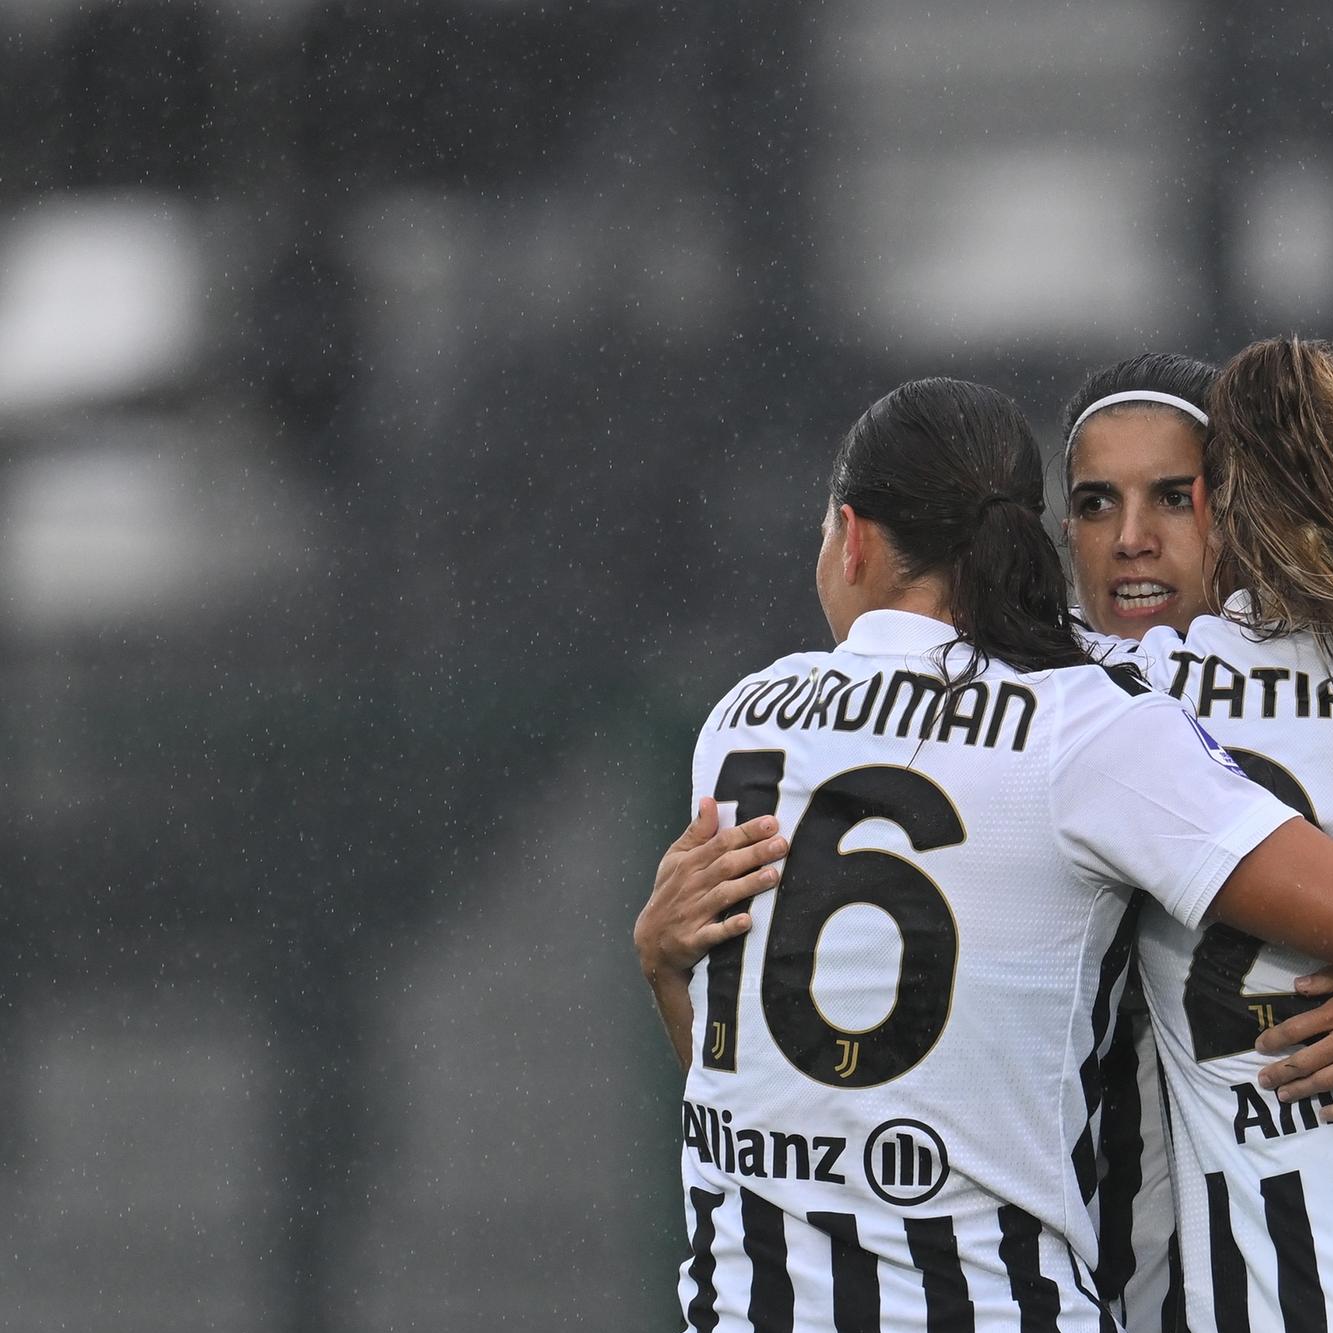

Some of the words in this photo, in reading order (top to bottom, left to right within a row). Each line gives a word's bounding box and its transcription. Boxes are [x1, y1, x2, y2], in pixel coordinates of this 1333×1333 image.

[716, 667, 1038, 753] NOORDMAN
[702, 748, 968, 1090] 16
[682, 1099, 848, 1185] Allianz
